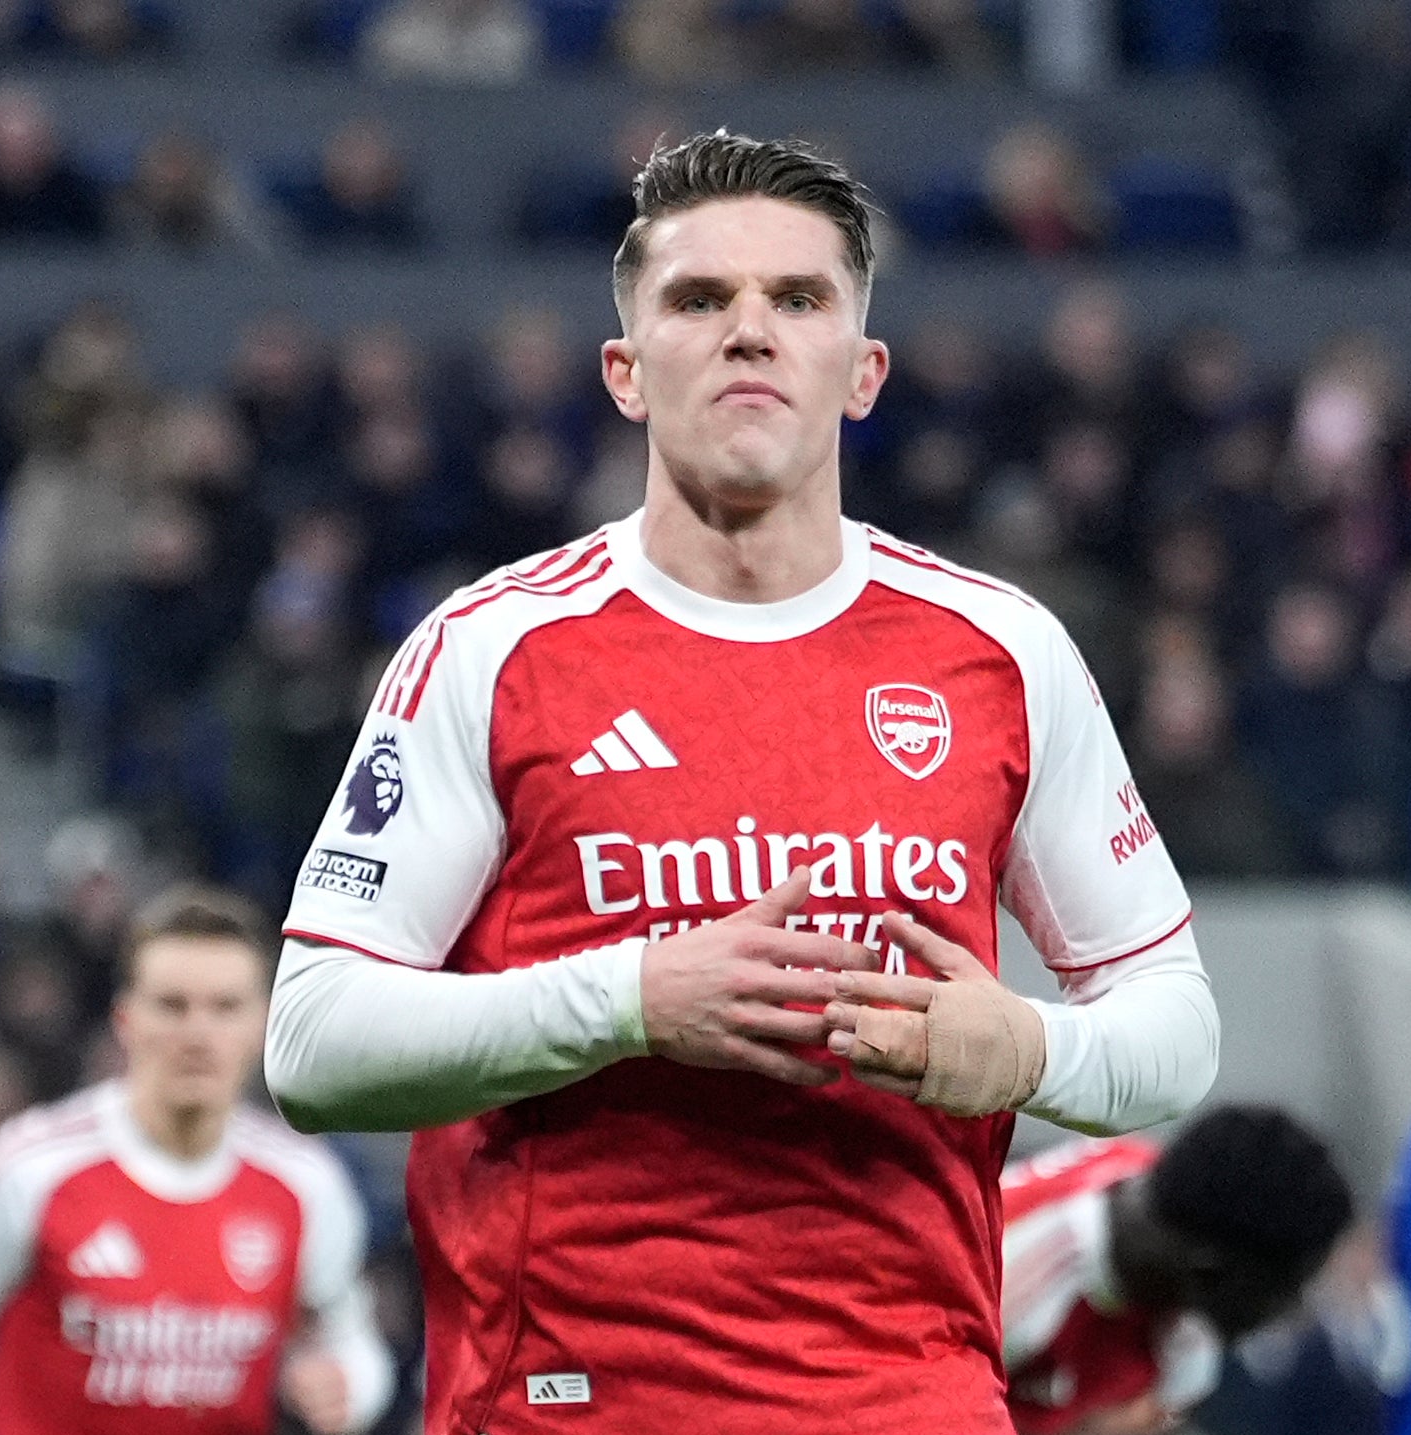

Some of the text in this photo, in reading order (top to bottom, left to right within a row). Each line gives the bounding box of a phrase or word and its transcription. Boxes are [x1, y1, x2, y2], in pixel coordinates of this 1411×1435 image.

[878, 699, 938, 719] Arsenal
[326, 855, 378, 882] room
[573, 816, 968, 915] Emirates
[317, 872, 380, 901] racism
